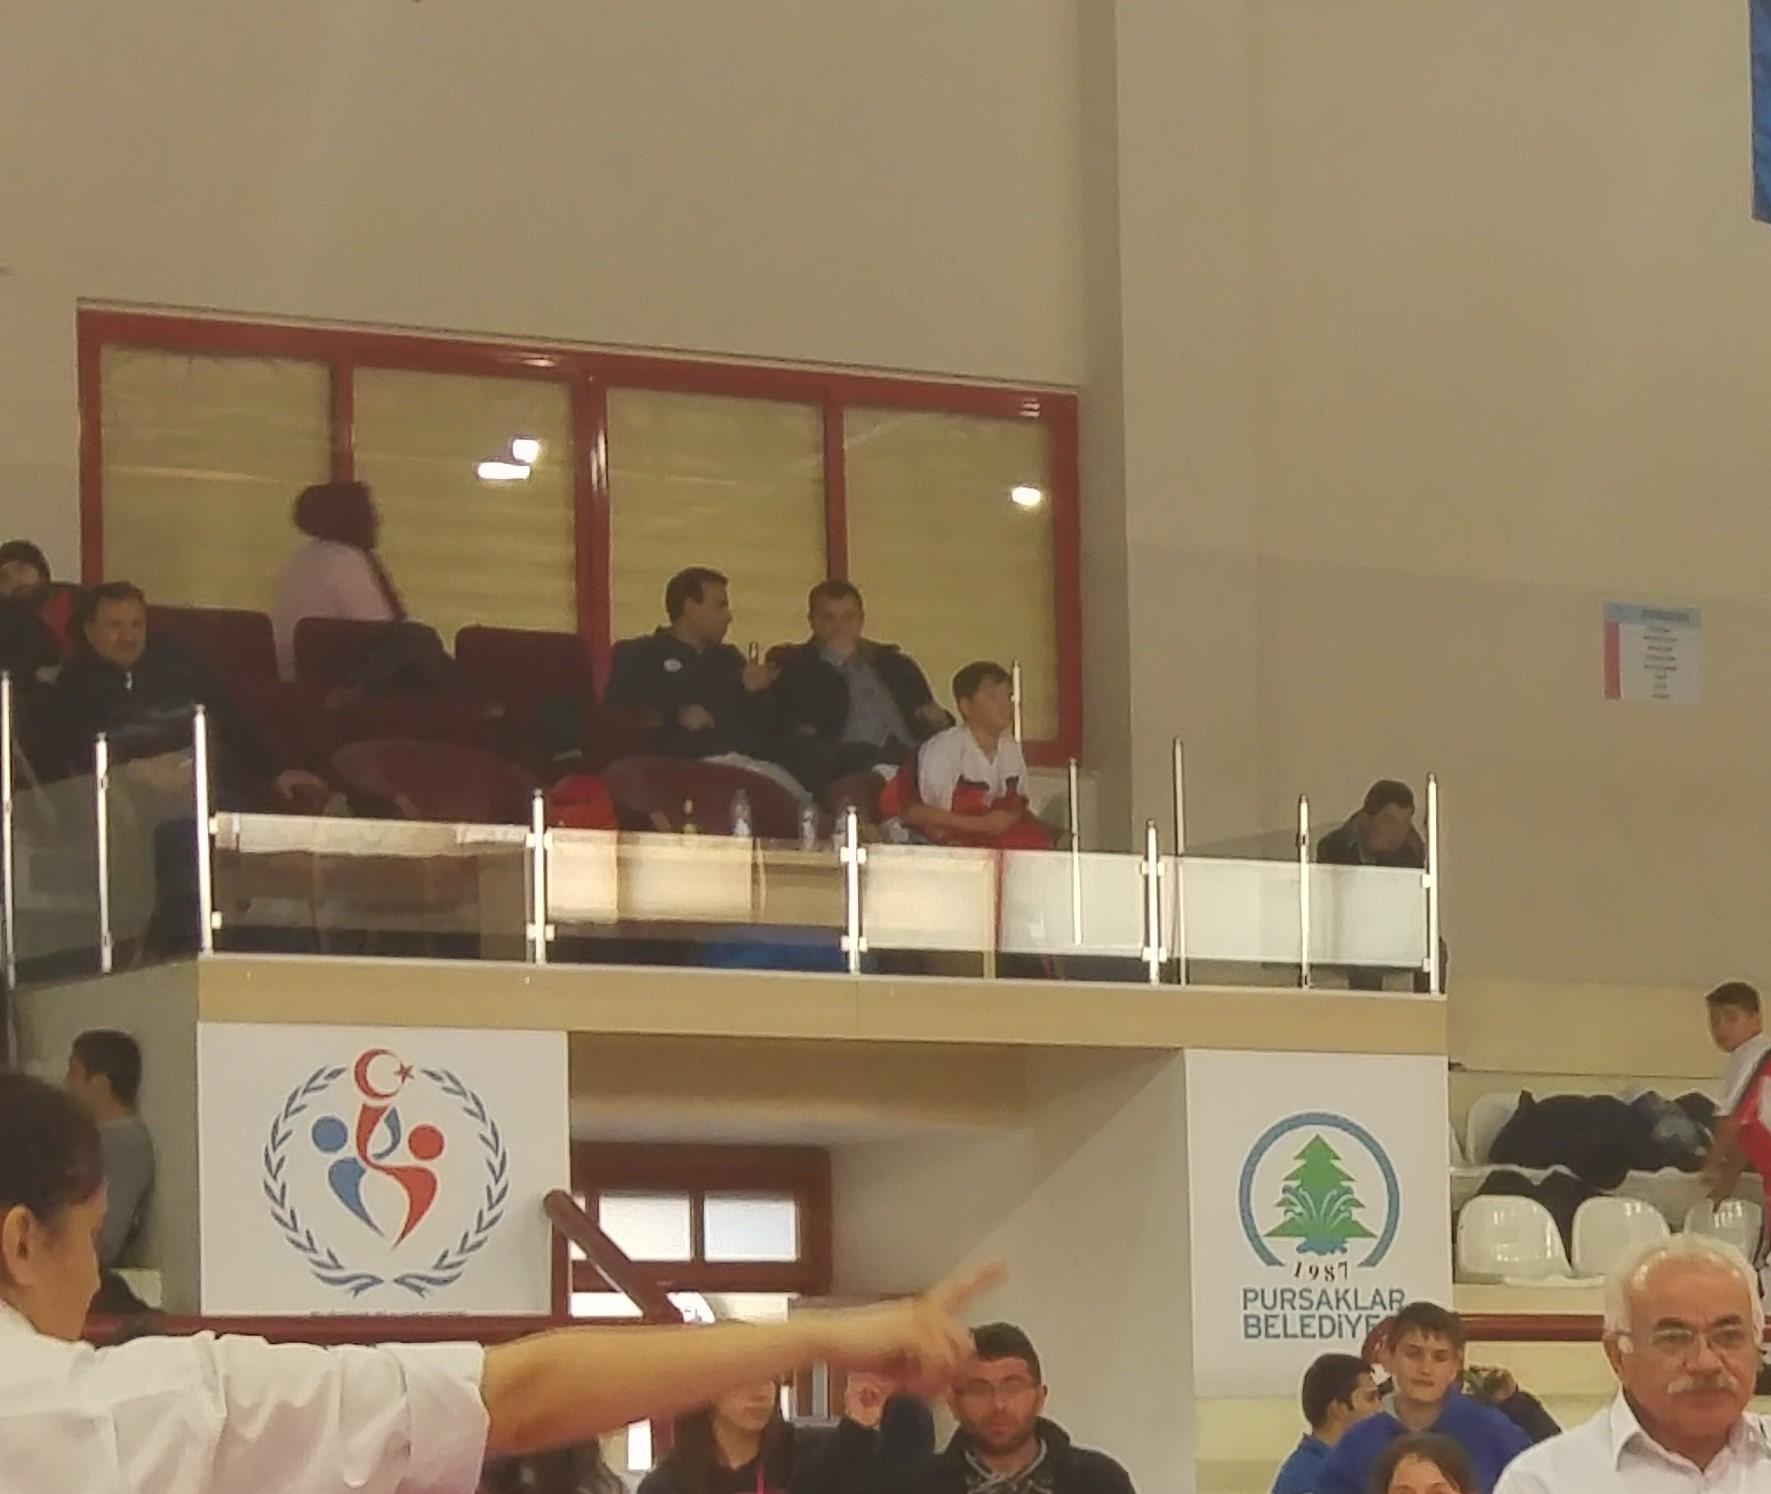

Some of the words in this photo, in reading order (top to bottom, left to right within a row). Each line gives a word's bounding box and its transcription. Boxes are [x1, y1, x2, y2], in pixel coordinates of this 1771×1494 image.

[1294, 1261, 1349, 1281] 1987
[1242, 1287, 1406, 1312] PURSAKLAR
[1243, 1313, 1380, 1339] BELEDİYE
